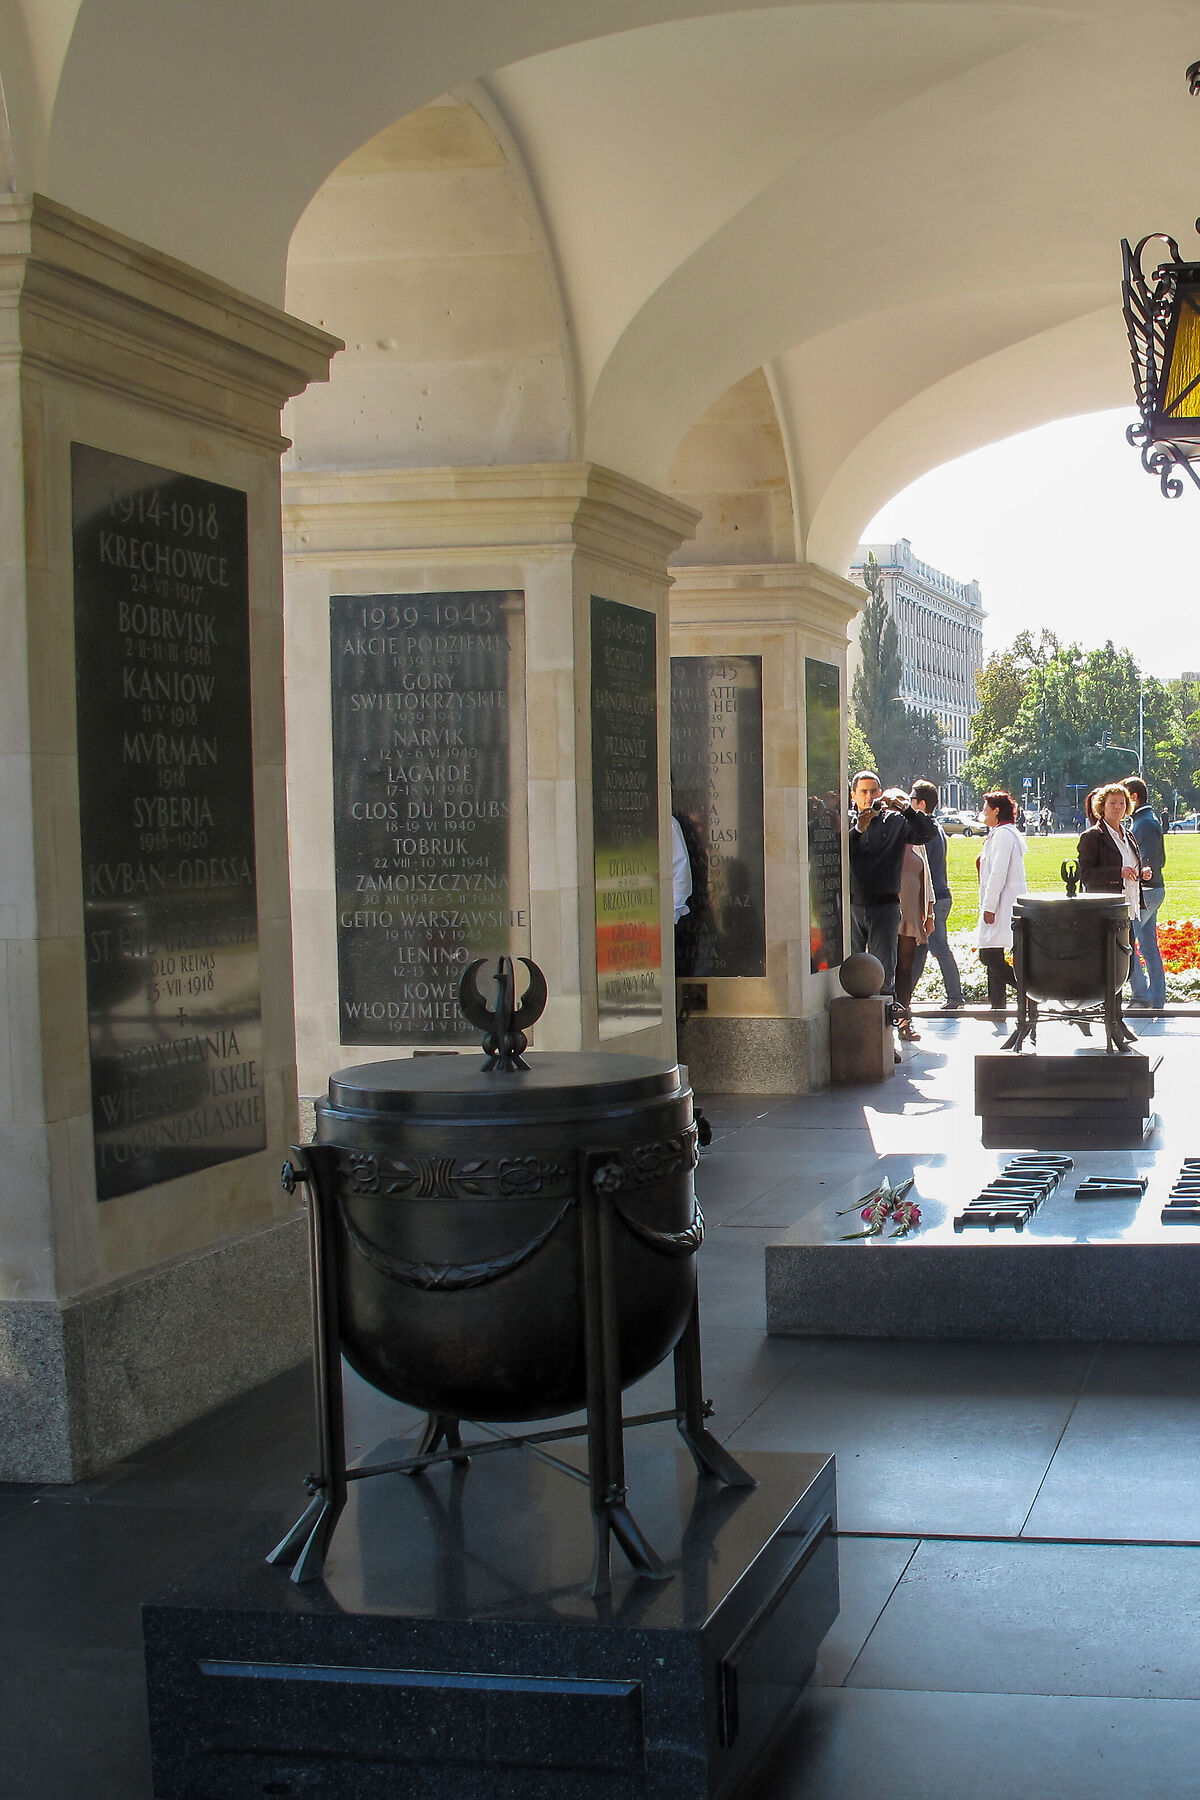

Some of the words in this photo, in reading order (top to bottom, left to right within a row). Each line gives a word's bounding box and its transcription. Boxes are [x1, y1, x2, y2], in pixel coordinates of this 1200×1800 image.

[100, 530, 229, 587] KRECHOWCE
[361, 604, 491, 630] 1939-1945
[393, 727, 464, 747] NARVIK
[122, 730, 218, 766] MVRMAN
[446, 748, 478, 760] 1940
[388, 764, 472, 783] LAGARDE
[442, 784, 474, 795] 1940
[352, 801, 399, 820] CLOS
[408, 802, 433, 819] DU
[443, 800, 510, 819] DOUBS
[444, 820, 476, 832] 1940
[393, 838, 468, 855] TOBRUK
[374, 858, 388, 869] 22
[462, 857, 489, 868] 1941
[341, 910, 393, 928] GETTO
[386, 929, 398, 941] 19
[181, 951, 216, 973] REIMS
[398, 946, 470, 964] LENINO
[404, 982, 459, 1000] KOWE
[344, 1001, 464, 1019] WŁODZIMIER
